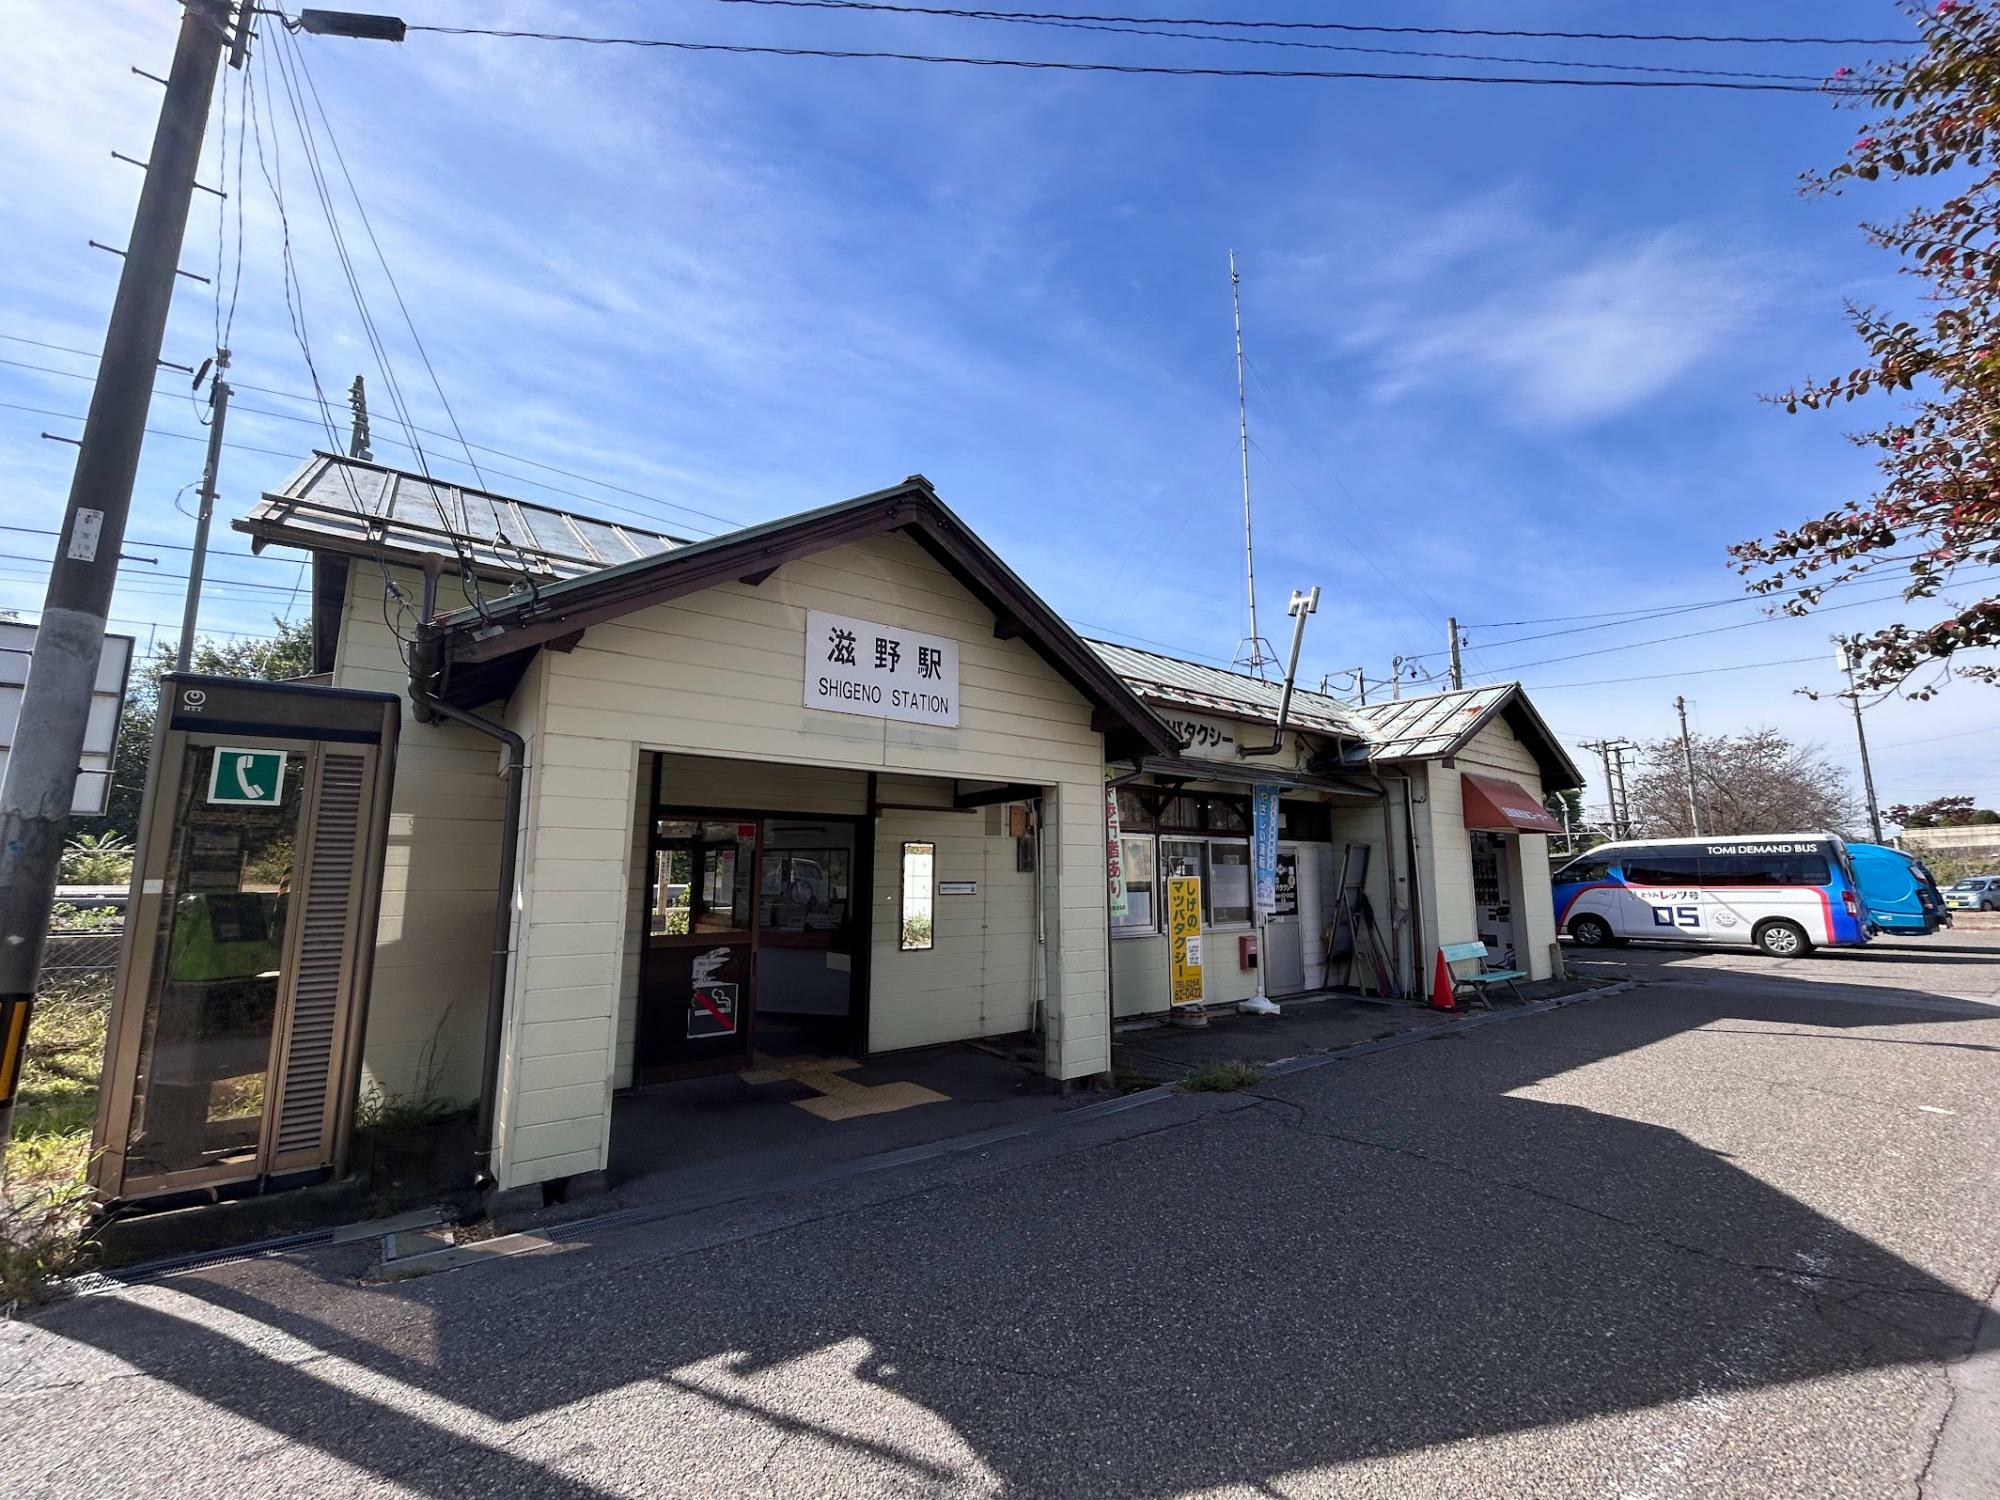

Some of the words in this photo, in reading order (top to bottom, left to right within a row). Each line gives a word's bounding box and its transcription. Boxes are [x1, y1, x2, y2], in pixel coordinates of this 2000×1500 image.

[827, 626, 942, 680] 滋野駅
[818, 677, 882, 703] SHIGENO
[891, 689, 949, 714] STATION
[1166, 719, 1233, 748] バタクシー
[1707, 846, 1736, 855] TOMI
[1738, 844, 1792, 854] DEMAND
[1794, 843, 1818, 853] BUS
[1186, 881, 1198, 928] しげの
[1652, 906, 1700, 927] 05
[1172, 881, 1186, 977] マツバタクシー
